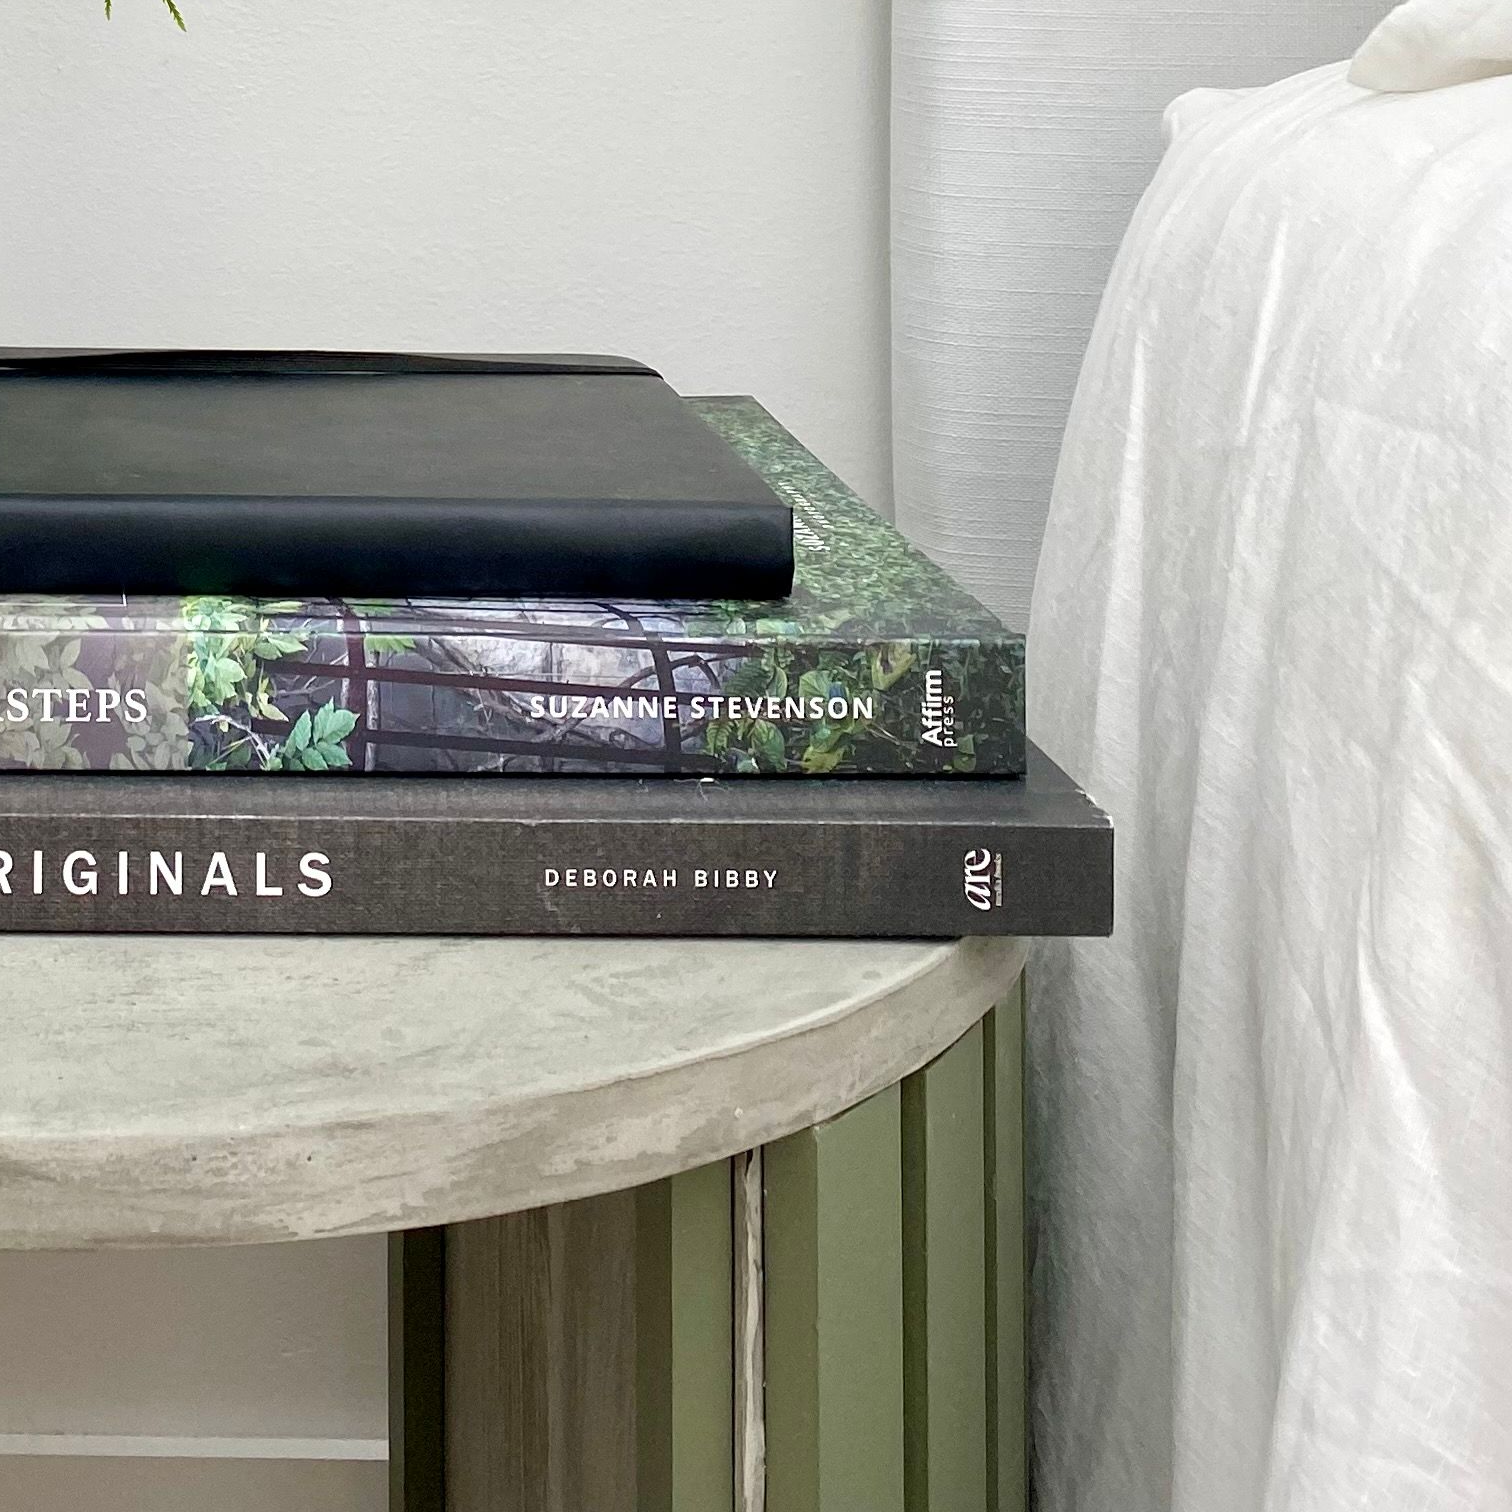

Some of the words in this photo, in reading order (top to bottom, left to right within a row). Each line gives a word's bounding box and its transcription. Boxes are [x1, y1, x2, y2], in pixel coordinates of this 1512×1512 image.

[530, 695, 677, 719] SUZANNE
[690, 696, 874, 719] STEVENSON
[922, 669, 943, 747] Affirm
[943, 695, 958, 748] press
[545, 868, 677, 888] DEBORAH
[694, 869, 777, 888] BIBBY
[964, 848, 991, 911] are
